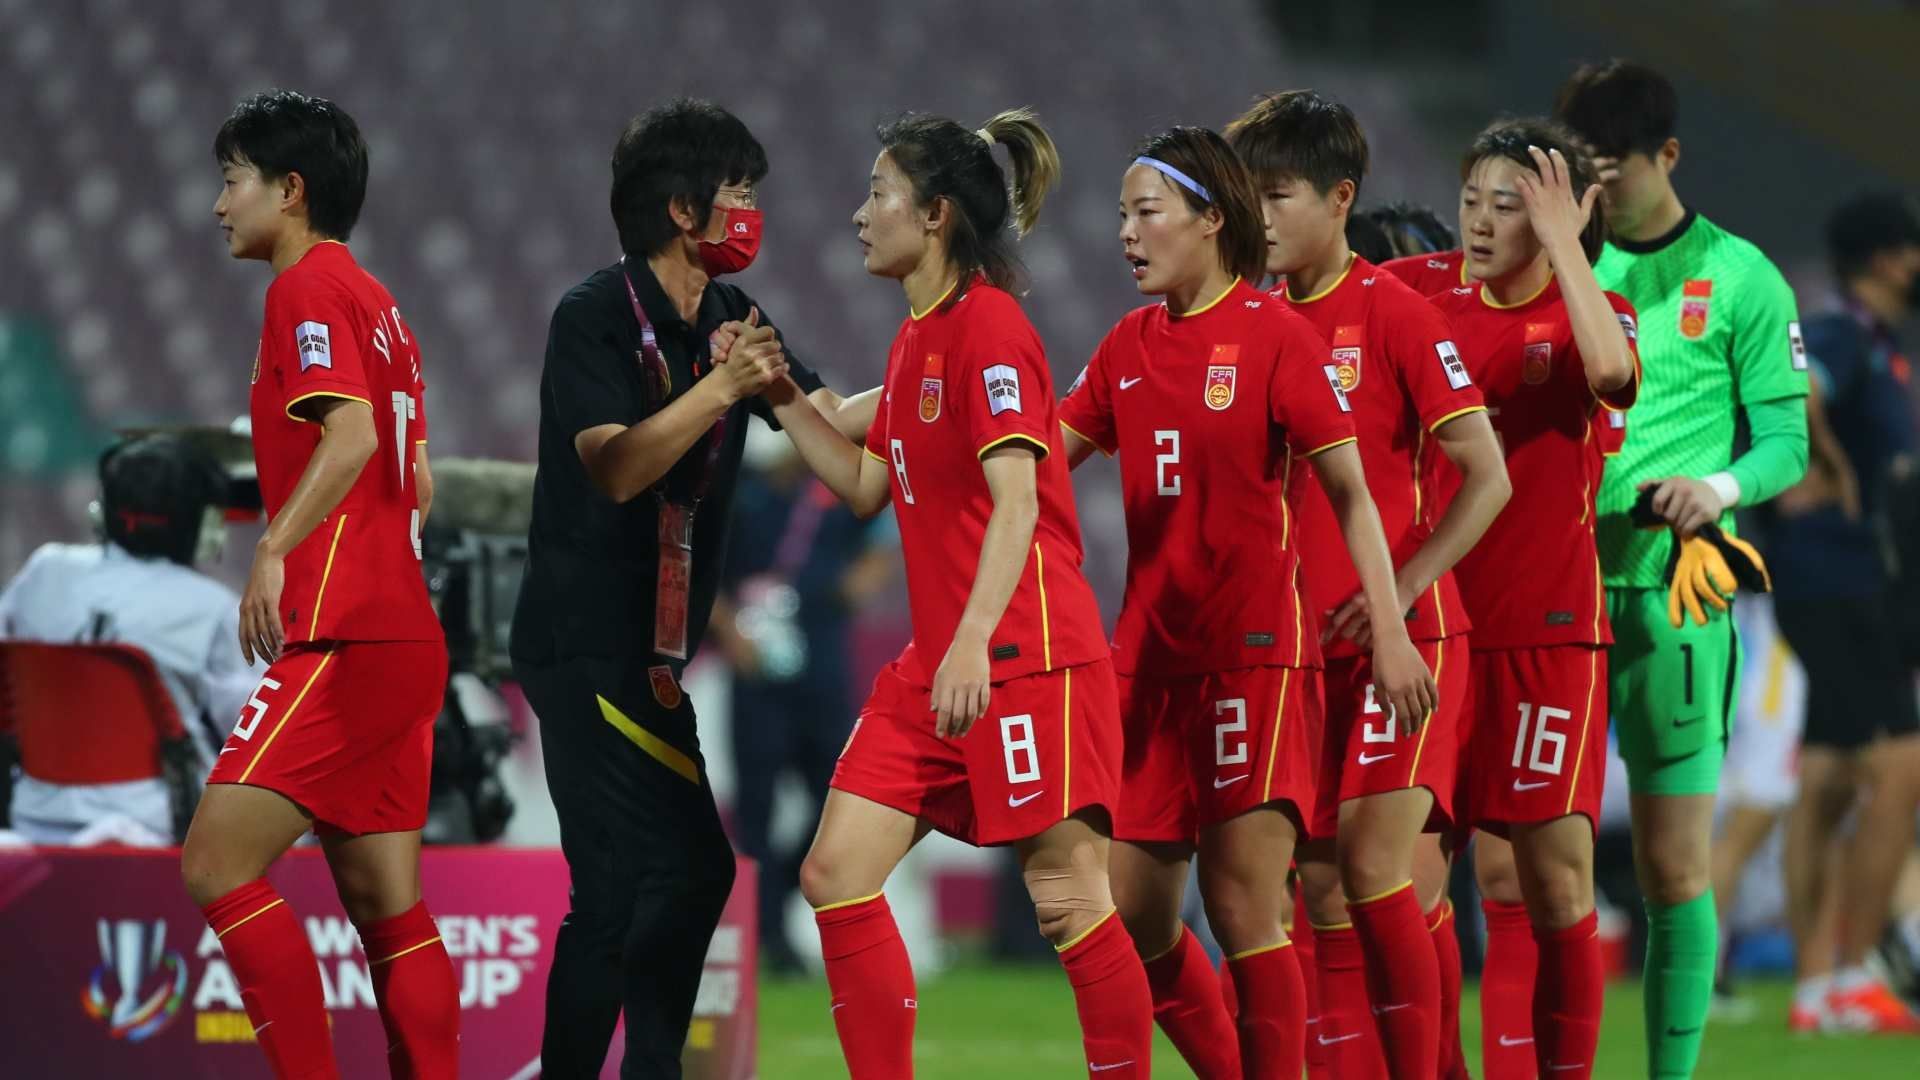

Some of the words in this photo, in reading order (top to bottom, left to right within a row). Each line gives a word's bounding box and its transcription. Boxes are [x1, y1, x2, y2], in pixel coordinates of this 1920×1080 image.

[988, 379, 1001, 391] OUR
[1002, 378, 1017, 390] GOAL
[992, 388, 1005, 400] FOR
[1007, 387, 1017, 398] ALL
[1211, 370, 1233, 379] CFA
[891, 439, 914, 504] 8
[1154, 430, 1181, 496] 2
[1680, 643, 1692, 705] 1
[999, 713, 1041, 784] 8
[1215, 698, 1248, 765] 2
[1511, 702, 1571, 776] 16
